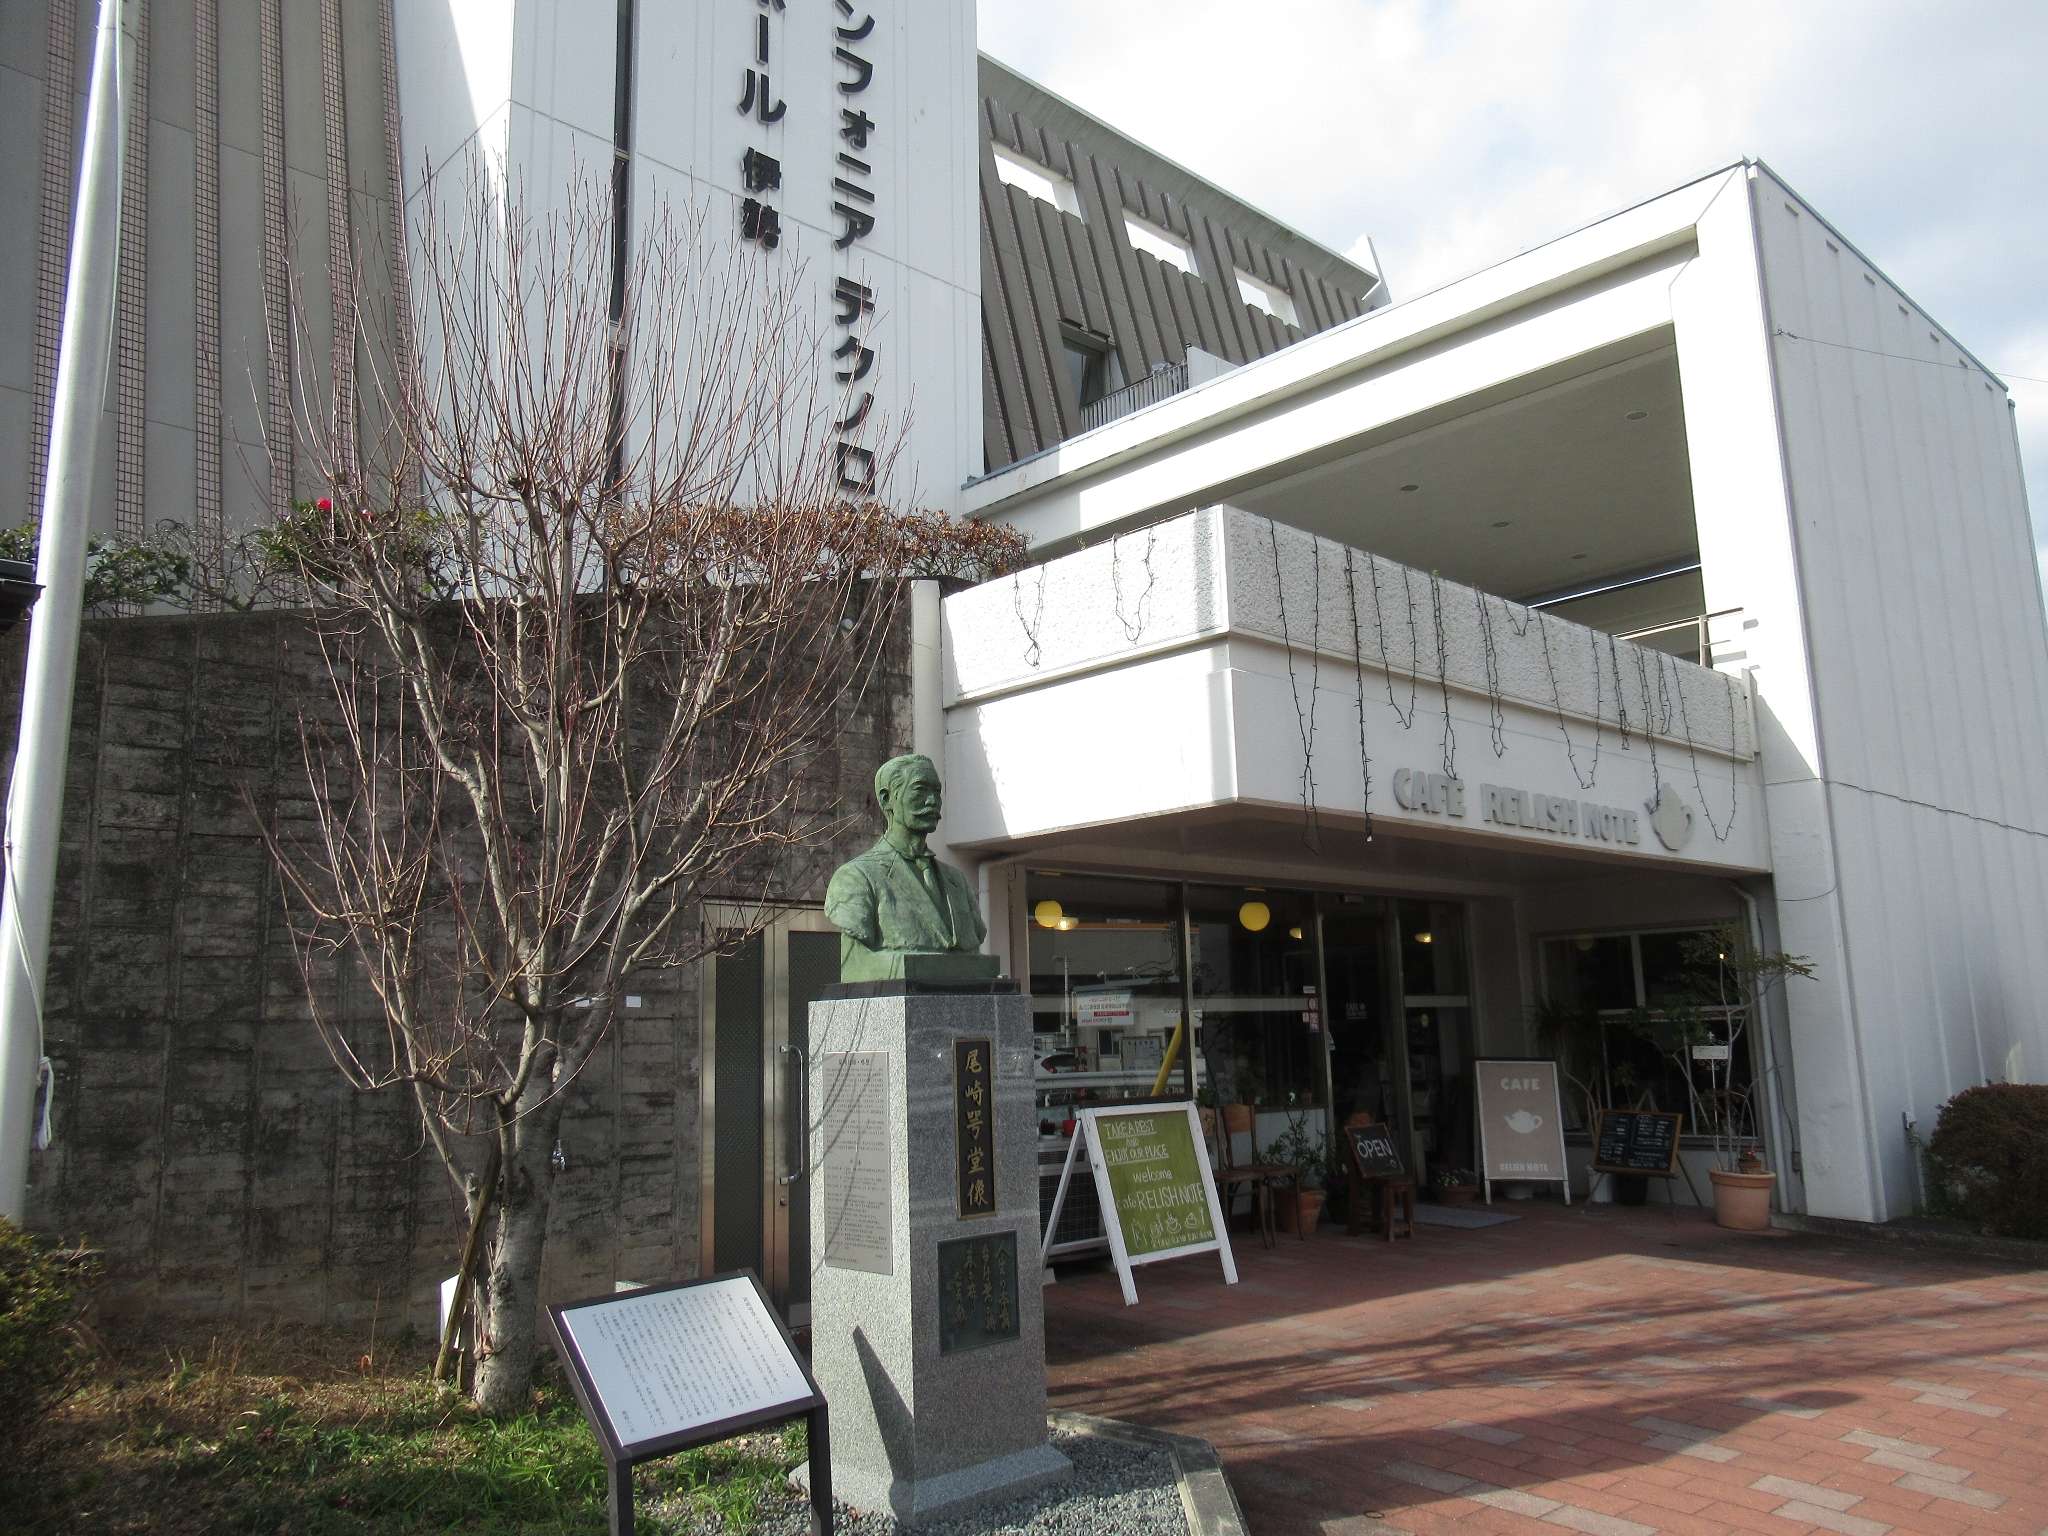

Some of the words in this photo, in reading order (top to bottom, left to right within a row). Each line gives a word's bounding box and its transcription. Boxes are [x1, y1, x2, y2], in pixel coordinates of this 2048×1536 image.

[1480, 783, 1577, 835] RELISH
[1580, 803, 1640, 845] NOTE
[1501, 1077, 1541, 1091] CAFE
[1357, 1136, 1393, 1159] OPEN
[1132, 1165, 1174, 1183] welcome
[1136, 1186, 1180, 1211] RELISH
[1179, 1183, 1204, 1206] NOTE
